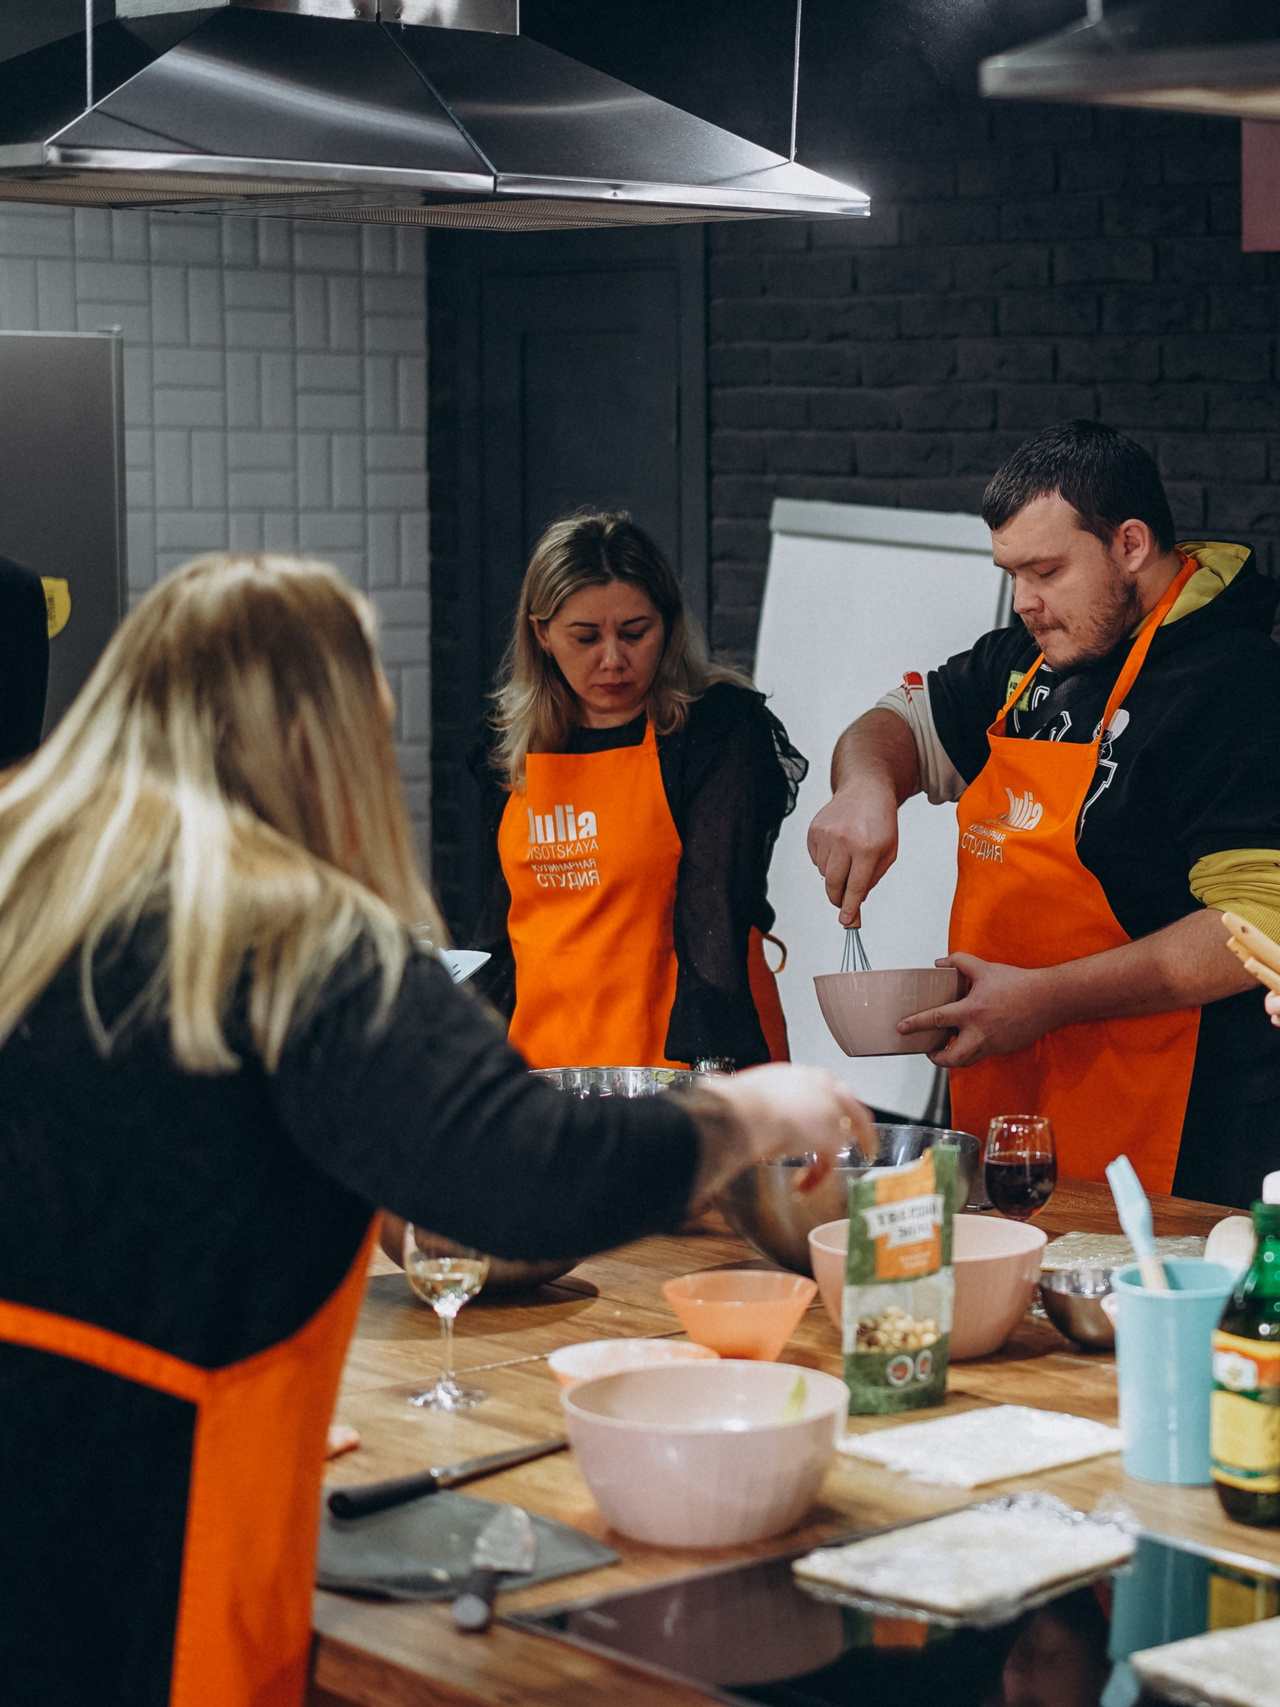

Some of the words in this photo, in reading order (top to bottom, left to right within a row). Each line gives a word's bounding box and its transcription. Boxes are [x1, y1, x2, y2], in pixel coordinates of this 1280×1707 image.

[527, 804, 598, 844] Julia
[961, 832, 1003, 863] СТУДИЯ
[531, 857, 597, 872] КУЛИНАРНАЯ
[536, 869, 601, 890] СТУДИЯ
